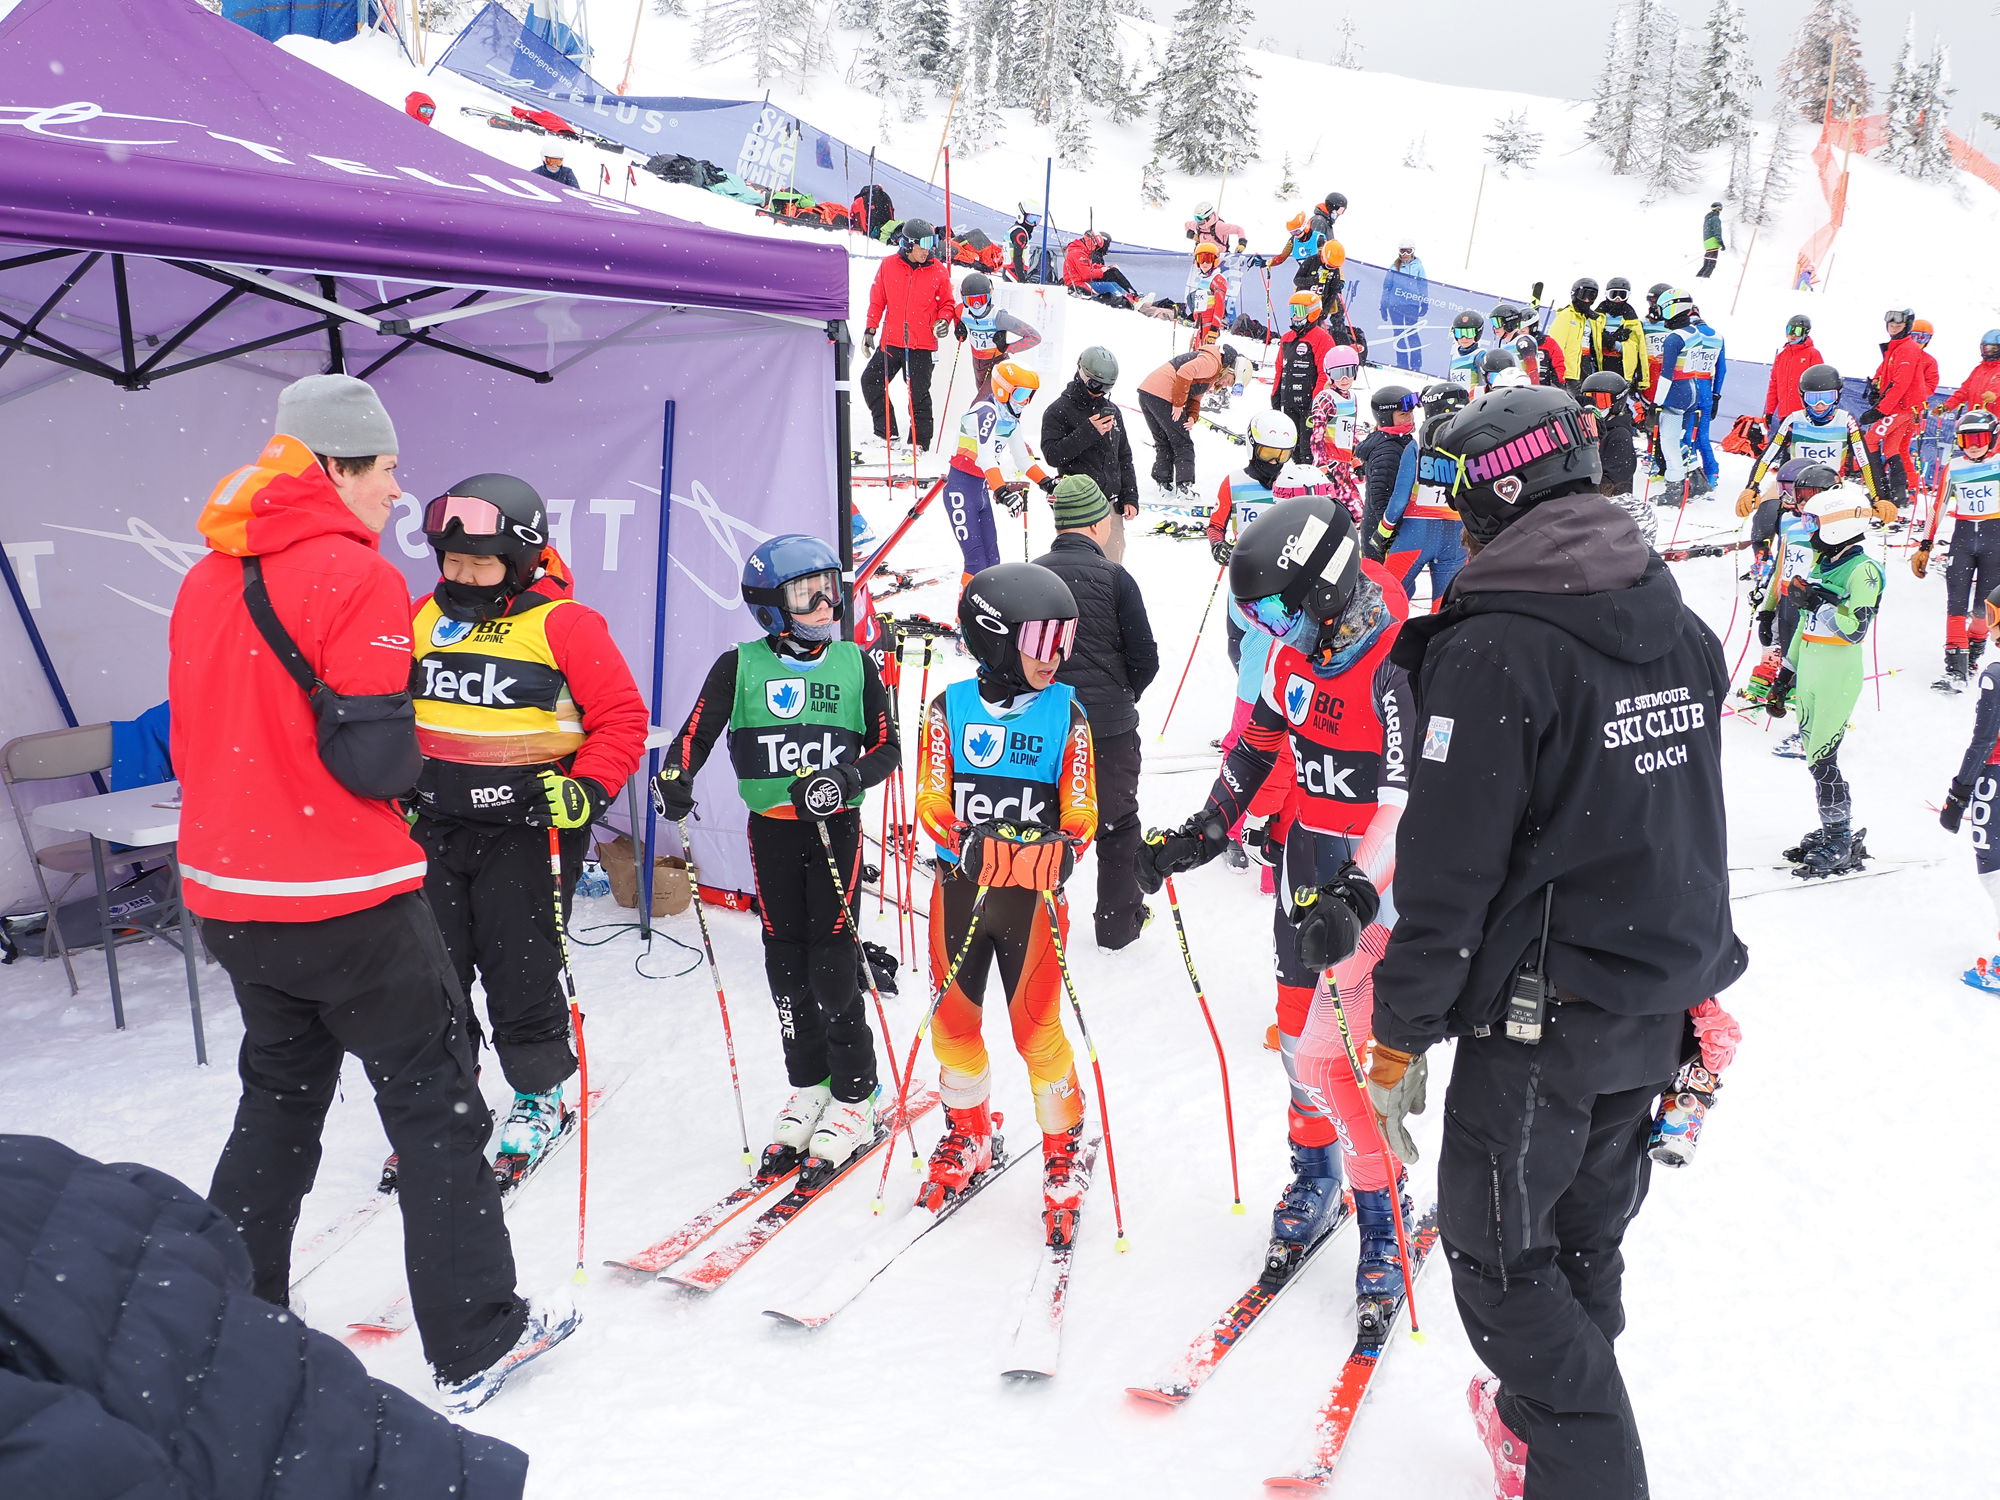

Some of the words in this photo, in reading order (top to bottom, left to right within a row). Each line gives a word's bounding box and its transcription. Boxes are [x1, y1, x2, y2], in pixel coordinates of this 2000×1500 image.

[513, 38, 559, 78] Experience
[740, 133, 796, 175] BIG
[206, 131, 641, 215] TELUS
[736, 159, 788, 192] WHITE
[1394, 287, 1447, 308] Experience
[1649, 335, 1668, 345] Tec
[1702, 361, 1712, 371] 32
[1800, 446, 1837, 459] Teck
[1959, 485, 1993, 499] Teck
[1968, 500, 1985, 513] 40
[971, 593, 1002, 619] ATOMIC
[472, 634, 505, 644] ALPINE
[477, 620, 513, 635] BC
[421, 658, 519, 705] Teck
[810, 682, 841, 700] BC
[811, 701, 838, 714] ALPINE
[1314, 691, 1345, 720] BC
[1615, 698, 1635, 715] MT.
[1635, 686, 1691, 711] SEYMOUR
[1313, 715, 1340, 736] ALPINE
[1381, 688, 1408, 782] KARBON
[1603, 715, 1645, 749] SKI
[1645, 703, 1705, 738] CLUB
[757, 732, 847, 773] Teck
[930, 707, 947, 794] KARBON
[1010, 731, 1044, 753] BC
[1010, 754, 1040, 767] ALPINE
[1071, 724, 1089, 809] KARBON
[1634, 744, 1688, 775] COACH
[1222, 761, 1244, 794] RBON
[470, 785, 514, 804] RDC
[568, 786, 578, 811] LEKI
[953, 781, 1047, 826] Teck
[685, 862, 700, 900] LEKI
[942, 953, 963, 989] LEKI
